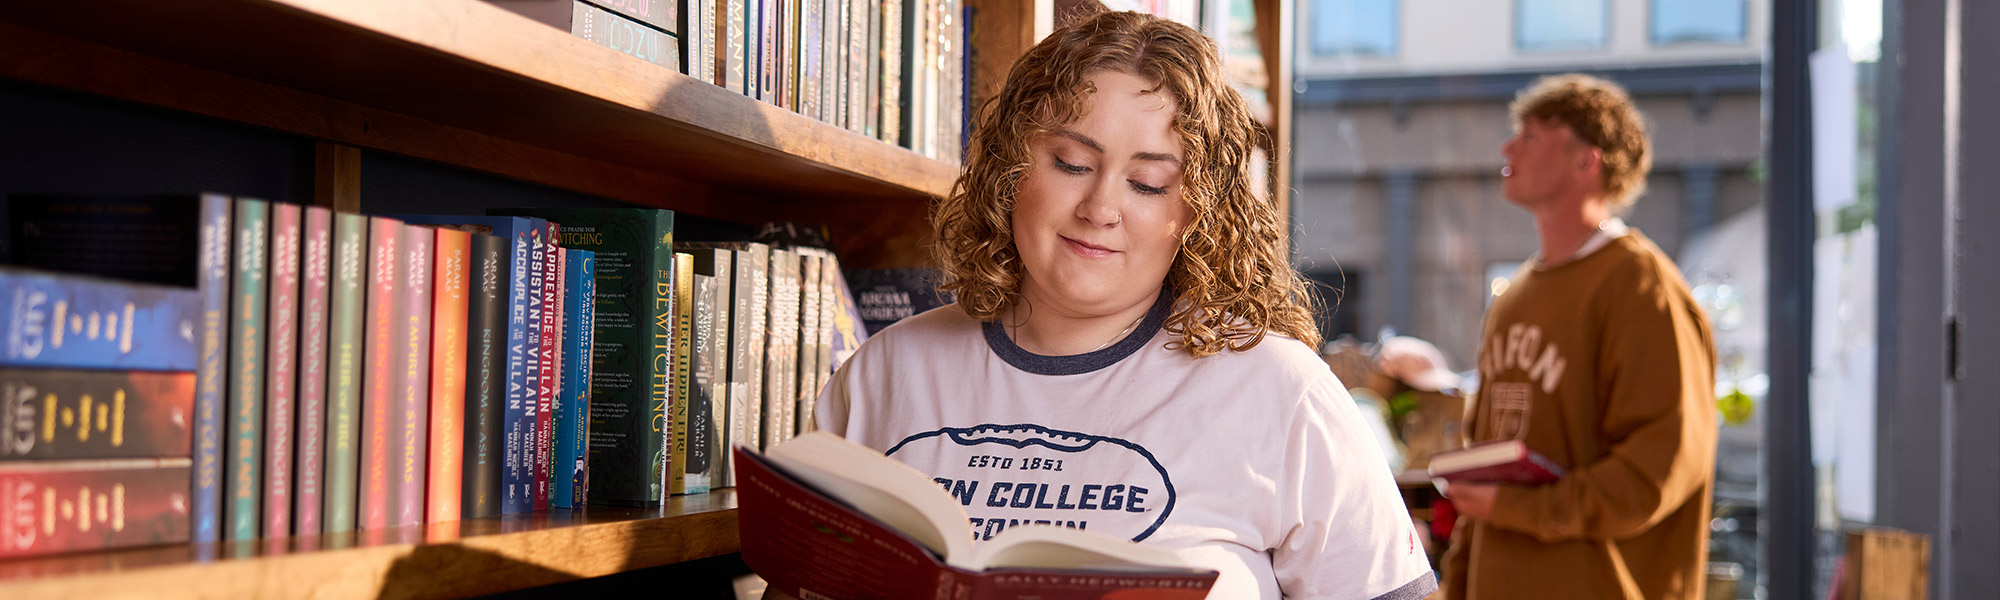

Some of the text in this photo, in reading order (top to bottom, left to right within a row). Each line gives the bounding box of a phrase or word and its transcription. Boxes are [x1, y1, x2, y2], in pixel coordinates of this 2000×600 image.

[376, 246, 384, 284] MAAS
[386, 237, 395, 282] SARAH
[408, 250, 417, 288] MAAS
[418, 242, 426, 288] SARAH
[560, 232, 603, 246] WITCHING
[454, 249, 462, 290] SARAH
[490, 250, 498, 290] SARAH
[514, 239, 528, 325] ACCOMPLICE
[528, 238, 544, 331] ASSISTANT
[544, 244, 556, 333] APPRENTICE
[408, 316, 420, 380] EMPIRE
[445, 328, 456, 388] TOWER
[652, 282, 670, 432] BEWITCHING
[737, 298, 747, 370] RECKONING
[480, 328, 491, 408] KINGDOM
[510, 344, 523, 410] VILLAIN
[525, 347, 539, 416] VILLAIN
[540, 349, 552, 412] VILLAIN
[676, 314, 688, 456] HER HIDDEN FIRE
[404, 410, 416, 484] STORMS
[442, 418, 453, 472] DAWN
[478, 432, 488, 465] ASH
[967, 455, 1064, 472] ESTD 1851
[986, 482, 1149, 512] COLLEGE
[1070, 576, 1204, 588] HEPWORTH
